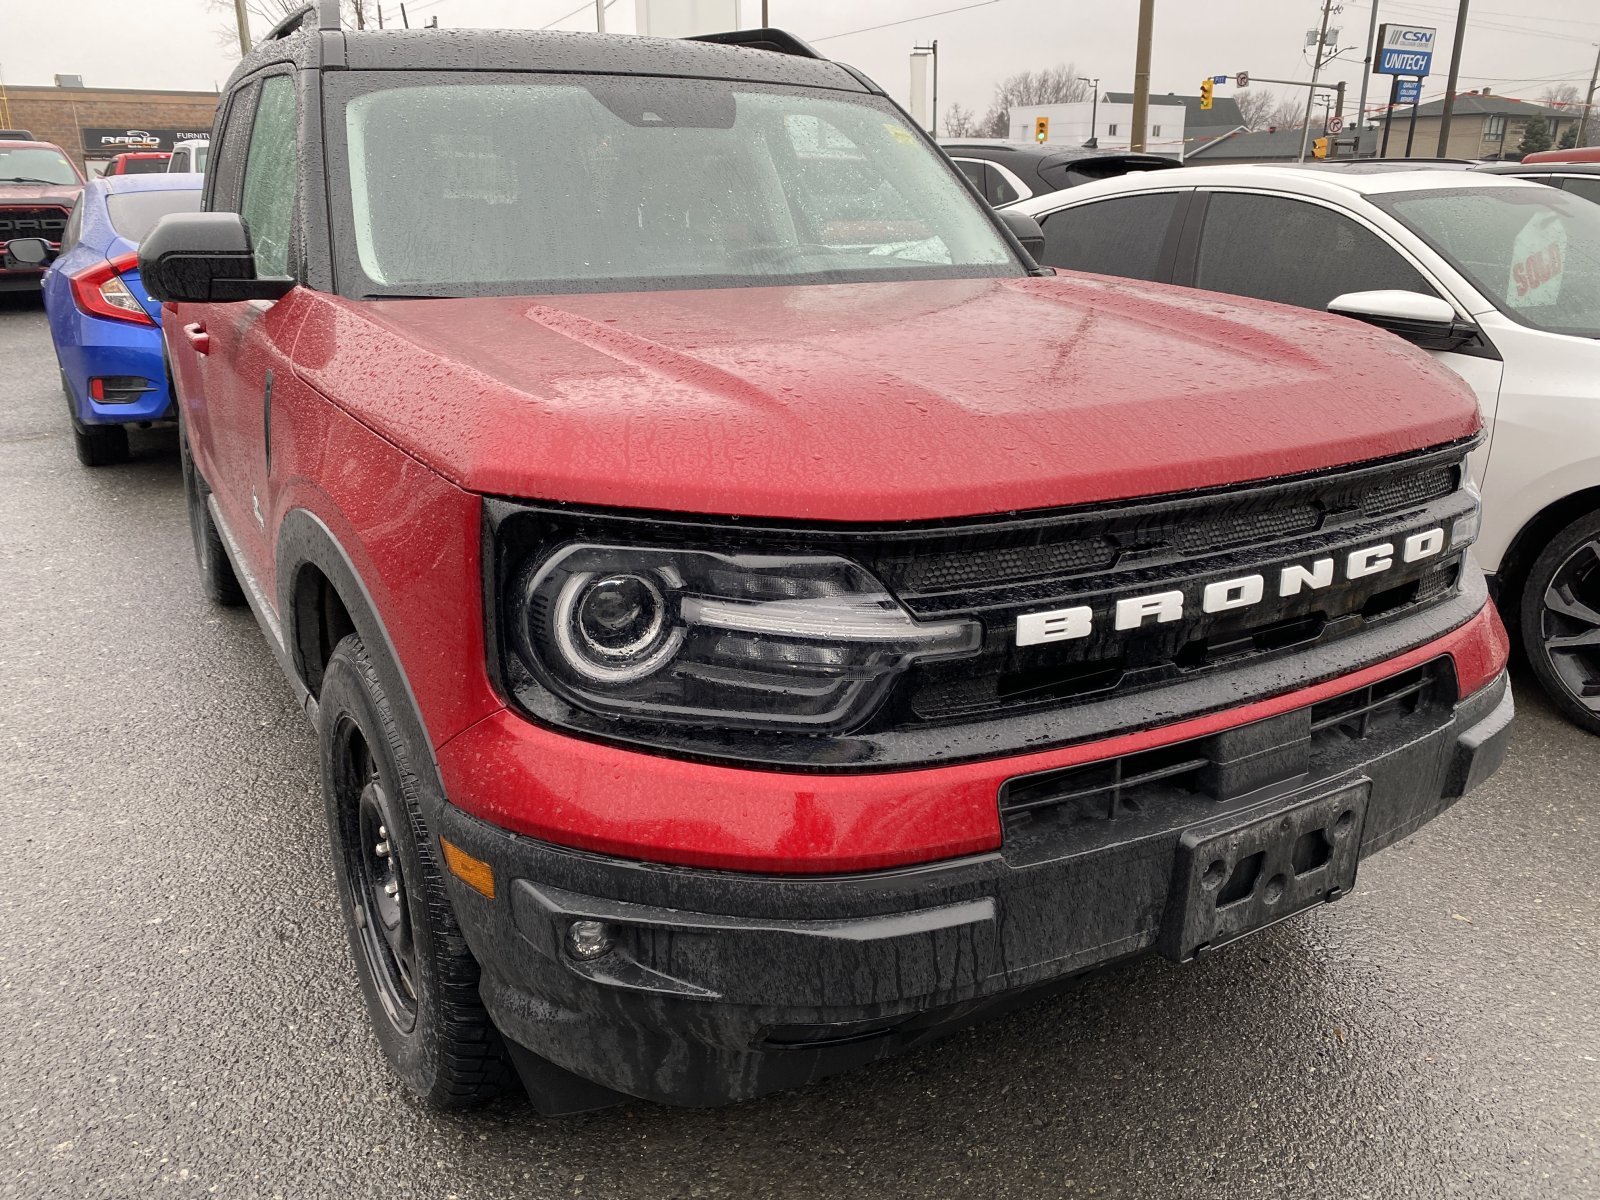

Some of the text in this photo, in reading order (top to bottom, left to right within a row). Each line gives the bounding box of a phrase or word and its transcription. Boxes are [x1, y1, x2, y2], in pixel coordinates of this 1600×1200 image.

[1402, 31, 1432, 42] CSN
[1384, 53, 1427, 71] UNITECH
[101, 136, 160, 144] RAPID
[1512, 241, 1562, 297] SOLD
[1015, 527, 1444, 647] BRONCO
